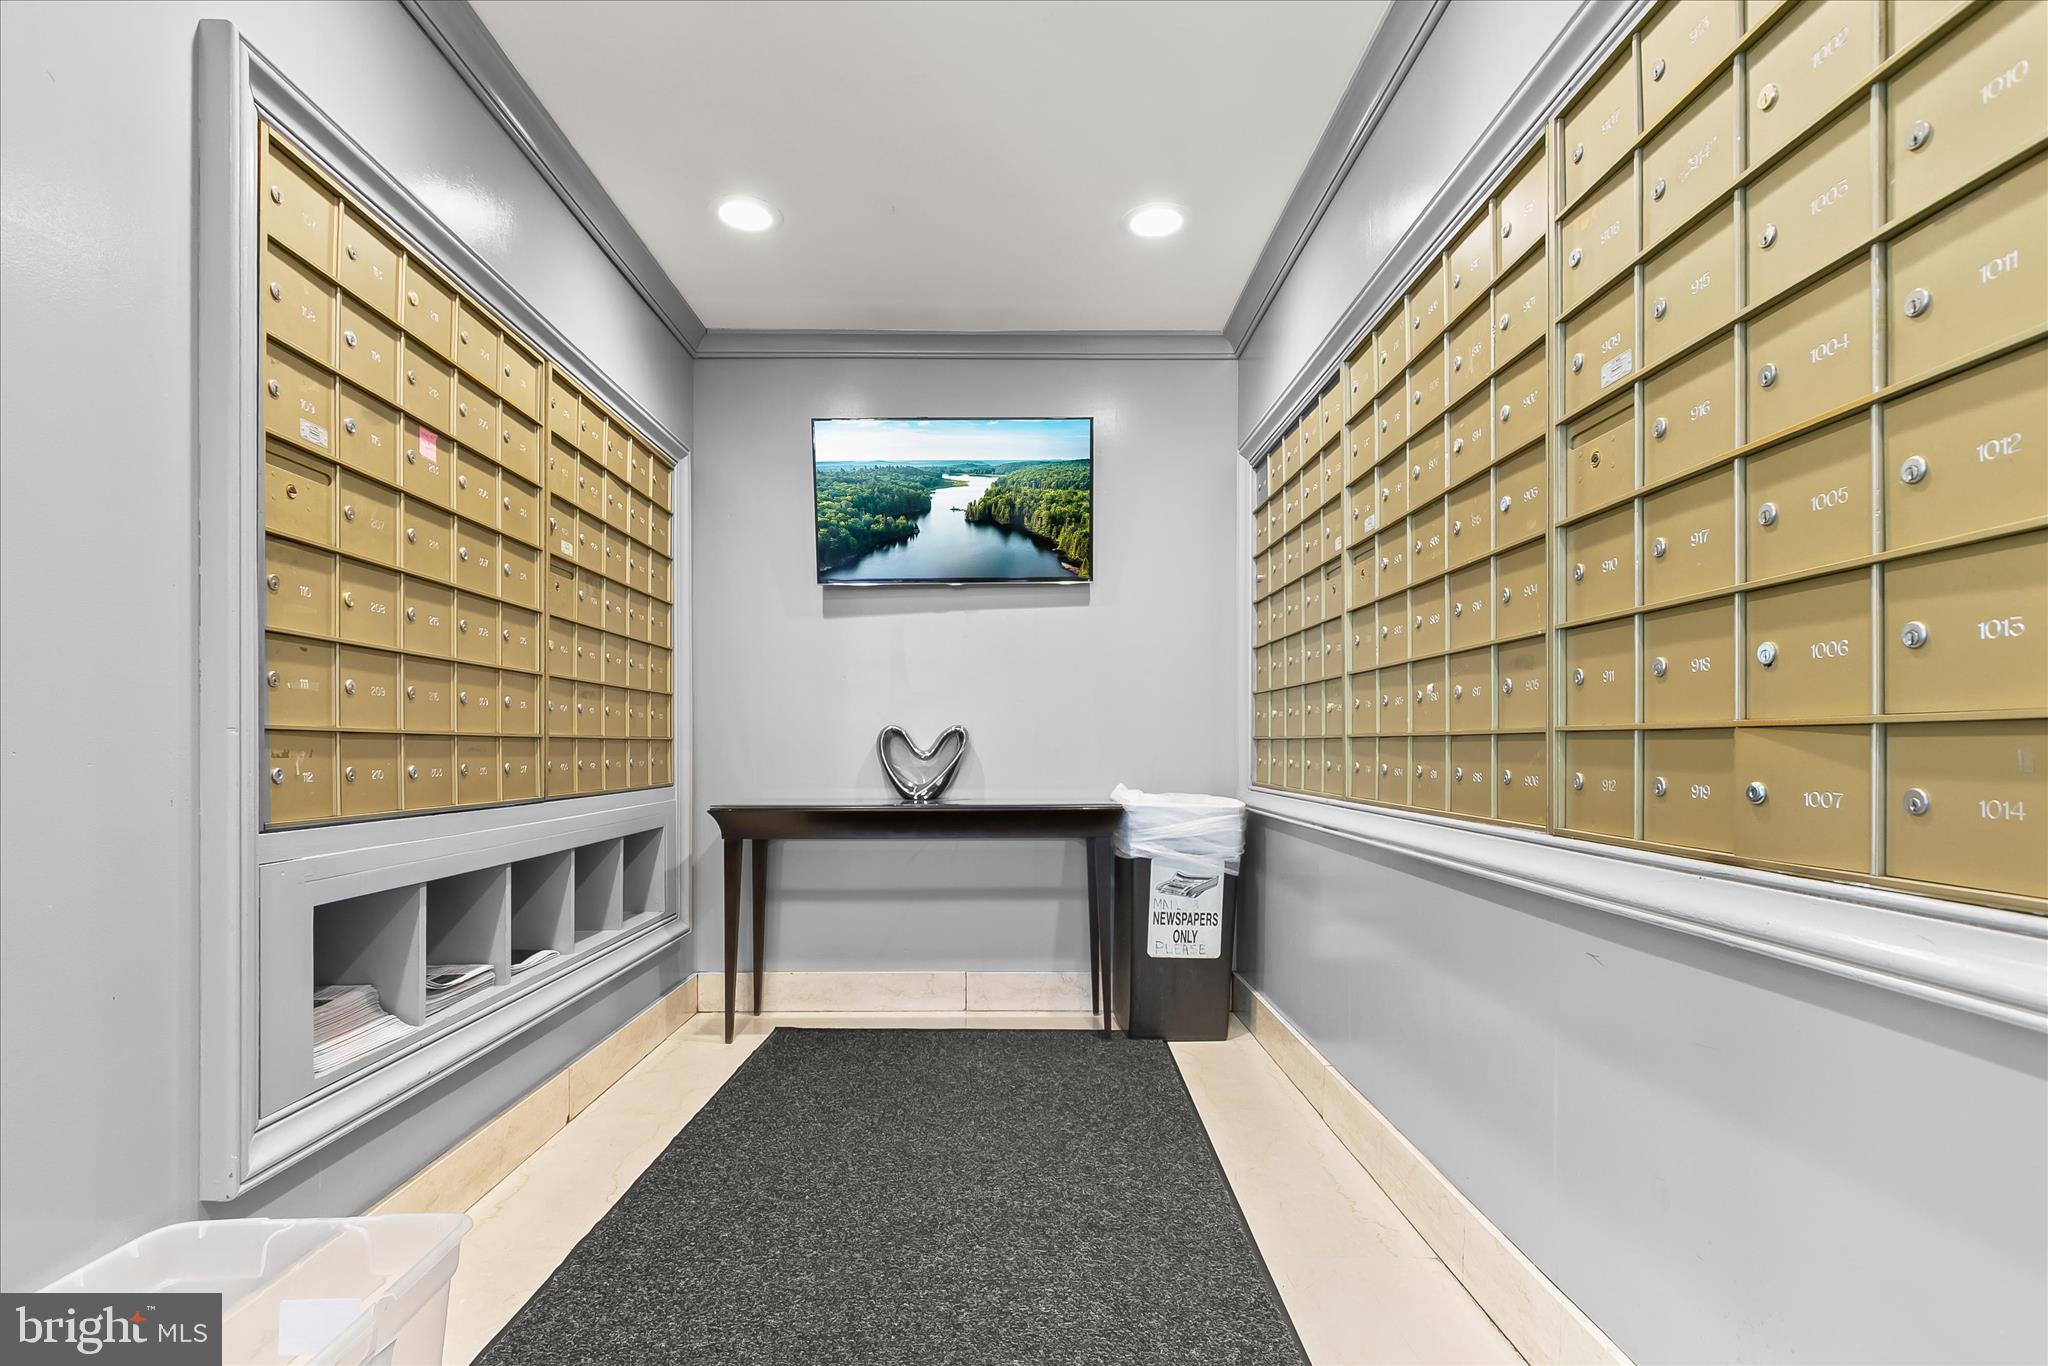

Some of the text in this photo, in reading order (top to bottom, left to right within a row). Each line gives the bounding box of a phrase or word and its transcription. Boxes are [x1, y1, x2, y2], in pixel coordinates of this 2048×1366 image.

[1981, 60, 2028, 103] 1010
[1979, 250, 2018, 283] 1011
[1810, 334, 1848, 363] 1004
[1691, 401, 1710, 420] 916
[1976, 433, 2021, 462] 1012
[1811, 487, 1848, 511] 1005
[1691, 529, 1709, 546] 917
[1602, 558, 1617, 572] 910
[1811, 640, 1848, 658] 1006
[1691, 657, 1710, 672] 918
[1603, 671, 1614, 682] 911
[371, 686, 385, 696] 209
[1602, 780, 1616, 791] 912
[1691, 785, 1710, 799] 919
[1804, 792, 1843, 808] 1007
[1979, 800, 2025, 820] 1014
[1152, 911, 1219, 926] NEWSPAPERS
[1172, 929, 1198, 944] ONLY
[1155, 940, 1206, 955] PLEASE
